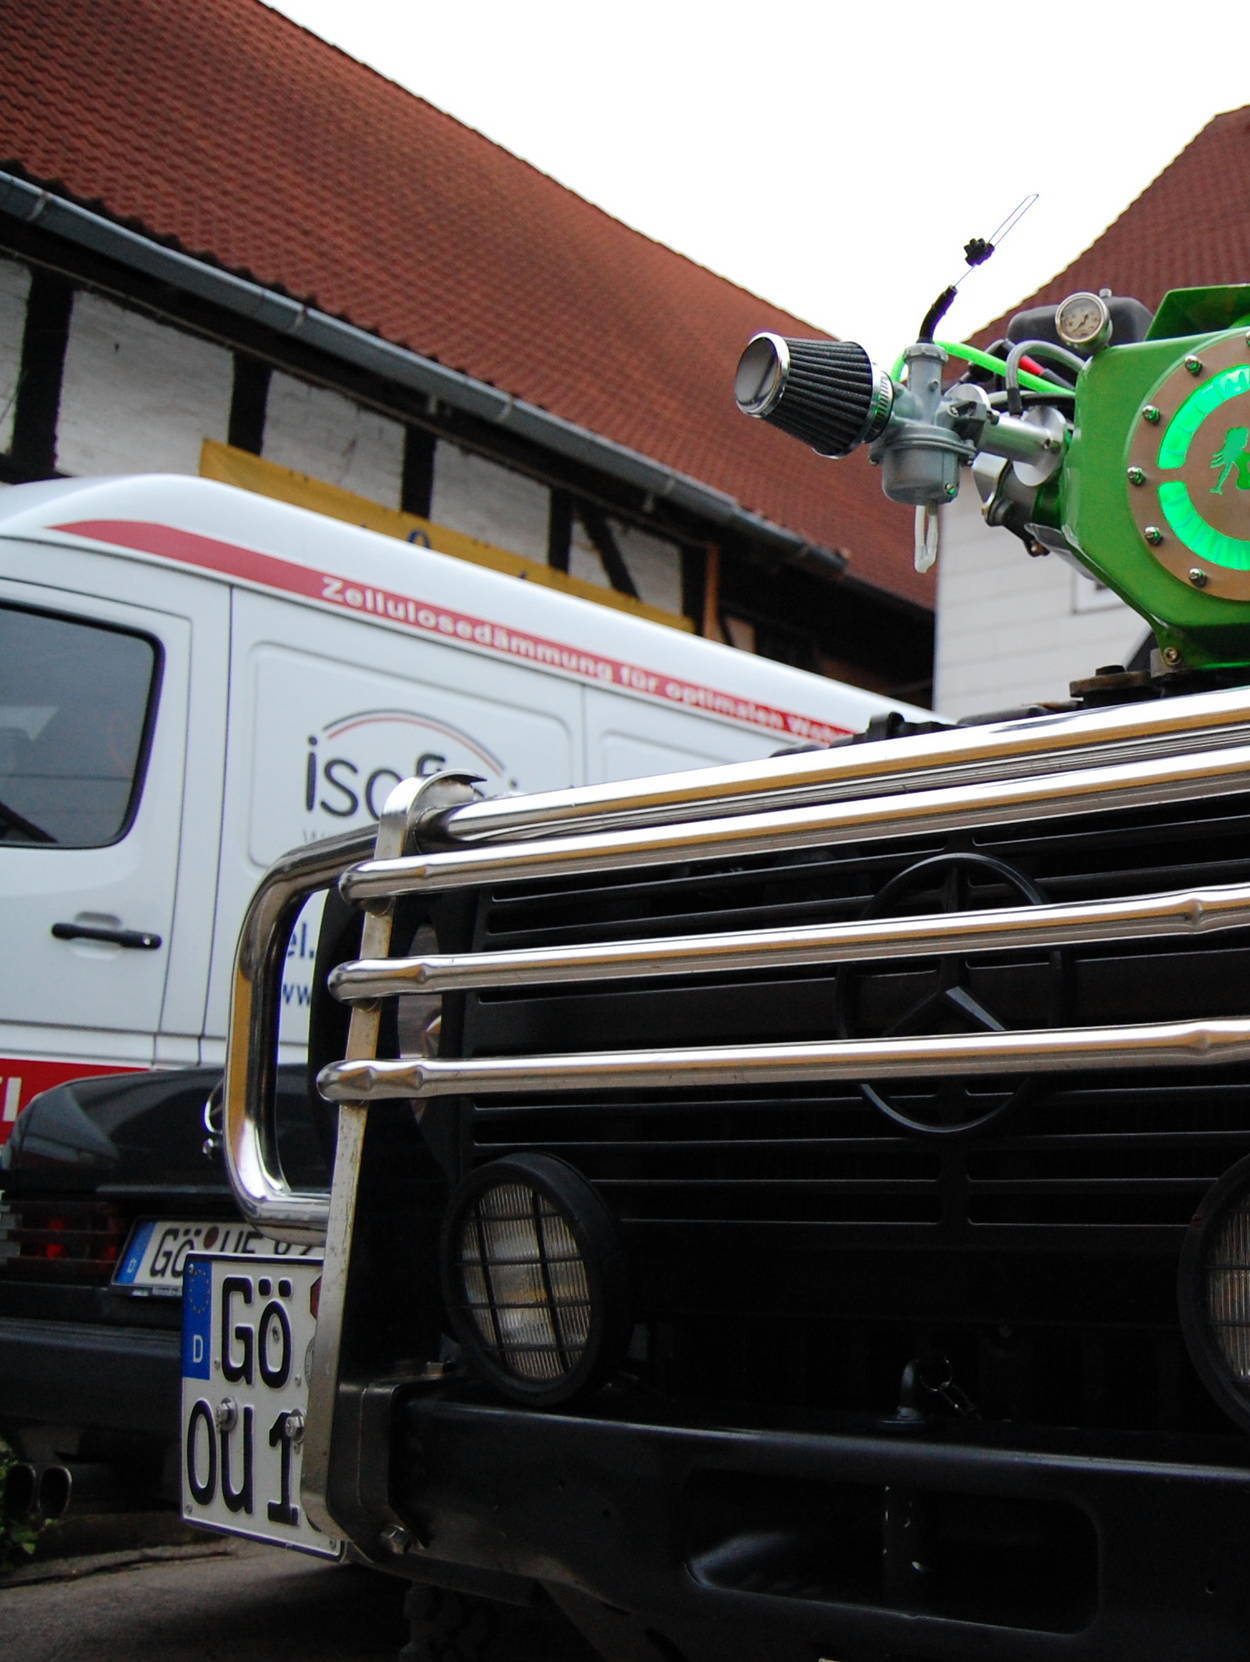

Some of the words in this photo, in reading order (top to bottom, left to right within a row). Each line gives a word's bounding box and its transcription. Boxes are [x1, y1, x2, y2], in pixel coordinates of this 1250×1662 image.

[321, 576, 613, 683] Zellulosedämmung
[620, 666, 659, 694] für
[665, 683, 784, 730] optimalen
[193, 1334, 204, 1363] D
[221, 1276, 293, 1389] GÖ
[186, 1399, 254, 1515] OU
[267, 1411, 300, 1525] 1
